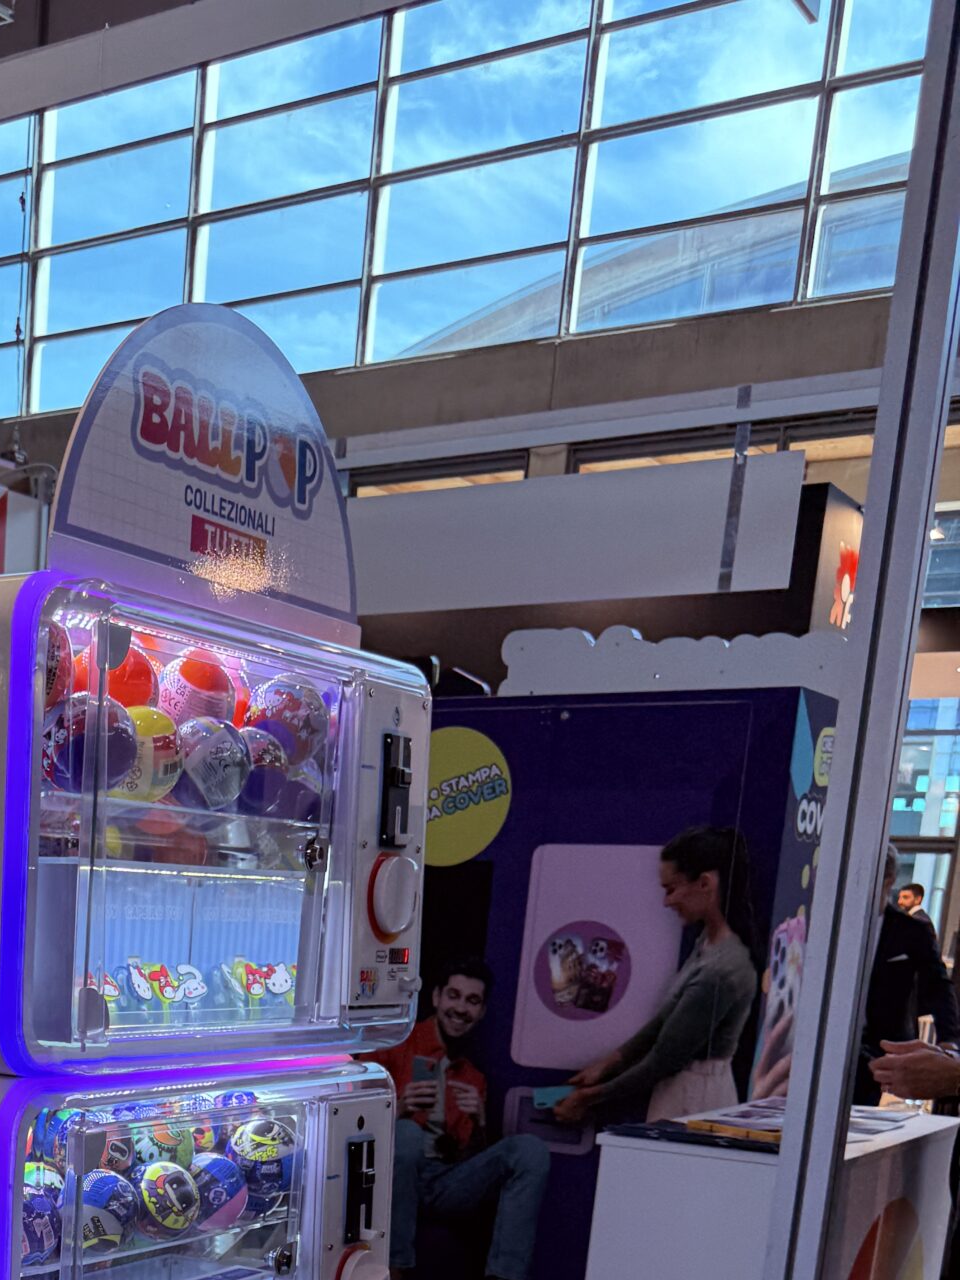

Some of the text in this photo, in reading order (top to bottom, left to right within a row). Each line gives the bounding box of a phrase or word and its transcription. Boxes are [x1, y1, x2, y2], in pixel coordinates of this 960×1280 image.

[184, 484, 276, 537] COLLEZIONALI
[440, 764, 501, 797] STAMPA
[442, 779, 507, 815] COVER
